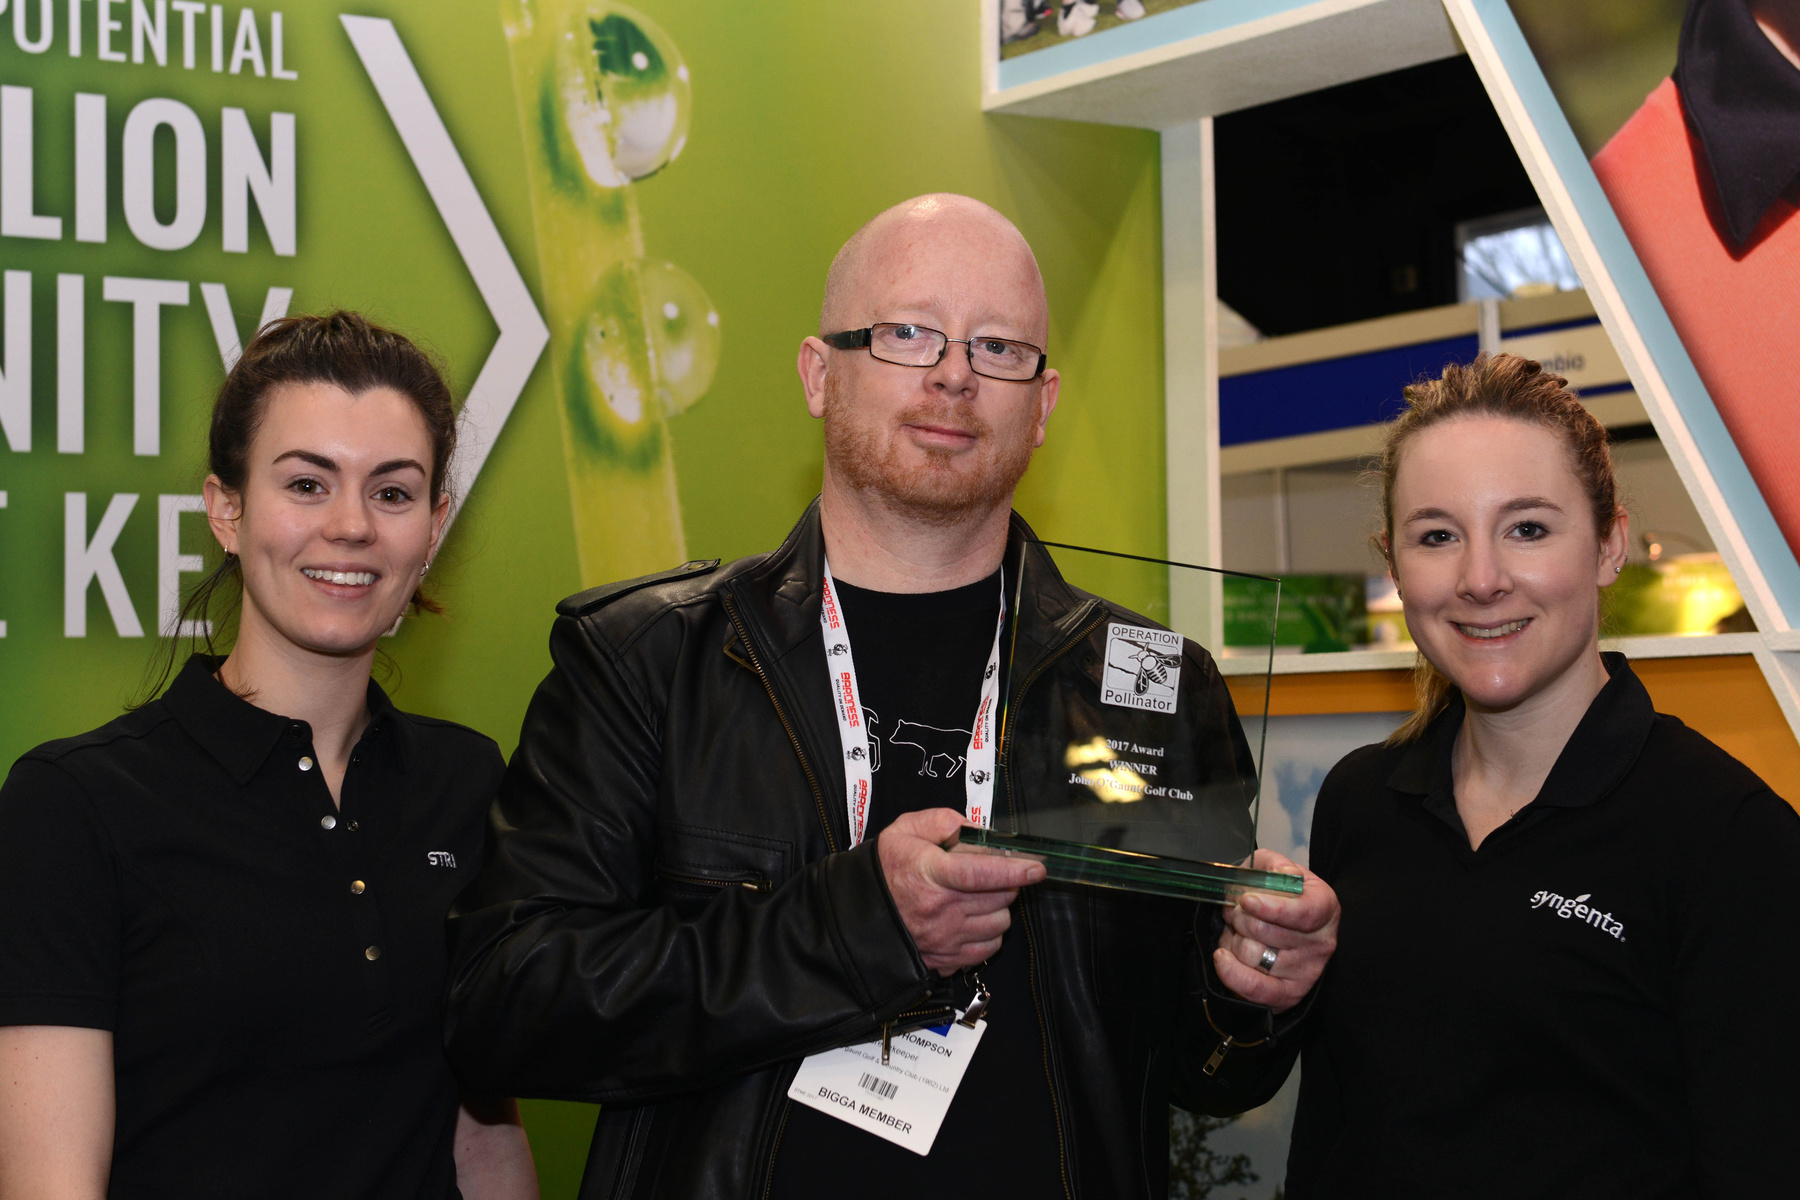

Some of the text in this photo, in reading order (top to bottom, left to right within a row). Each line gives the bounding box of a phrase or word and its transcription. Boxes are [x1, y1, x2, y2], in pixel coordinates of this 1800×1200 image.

[0, 0, 298, 80] OTENTIAL
[64, 492, 214, 638] KE
[823, 576, 840, 630] RONESS
[1112, 626, 1179, 645] OPERATION
[840, 671, 860, 728] BARONESS
[1105, 689, 1172, 711] Pollinator
[1106, 739, 1164, 757] 2017 Award
[1108, 758, 1157, 776] WINNER
[1068, 773, 1094, 786] John
[1144, 784, 1167, 797] Golf
[1168, 788, 1193, 801] Club
[427, 851, 457, 868] STRI
[1530, 890, 1624, 939] syngenta
[871, 1038, 920, 1062] rekeeper
[898, 1031, 953, 1058] HOMPSON
[817, 1086, 856, 1110] BIGGA
[858, 1104, 912, 1134] MEMBER
